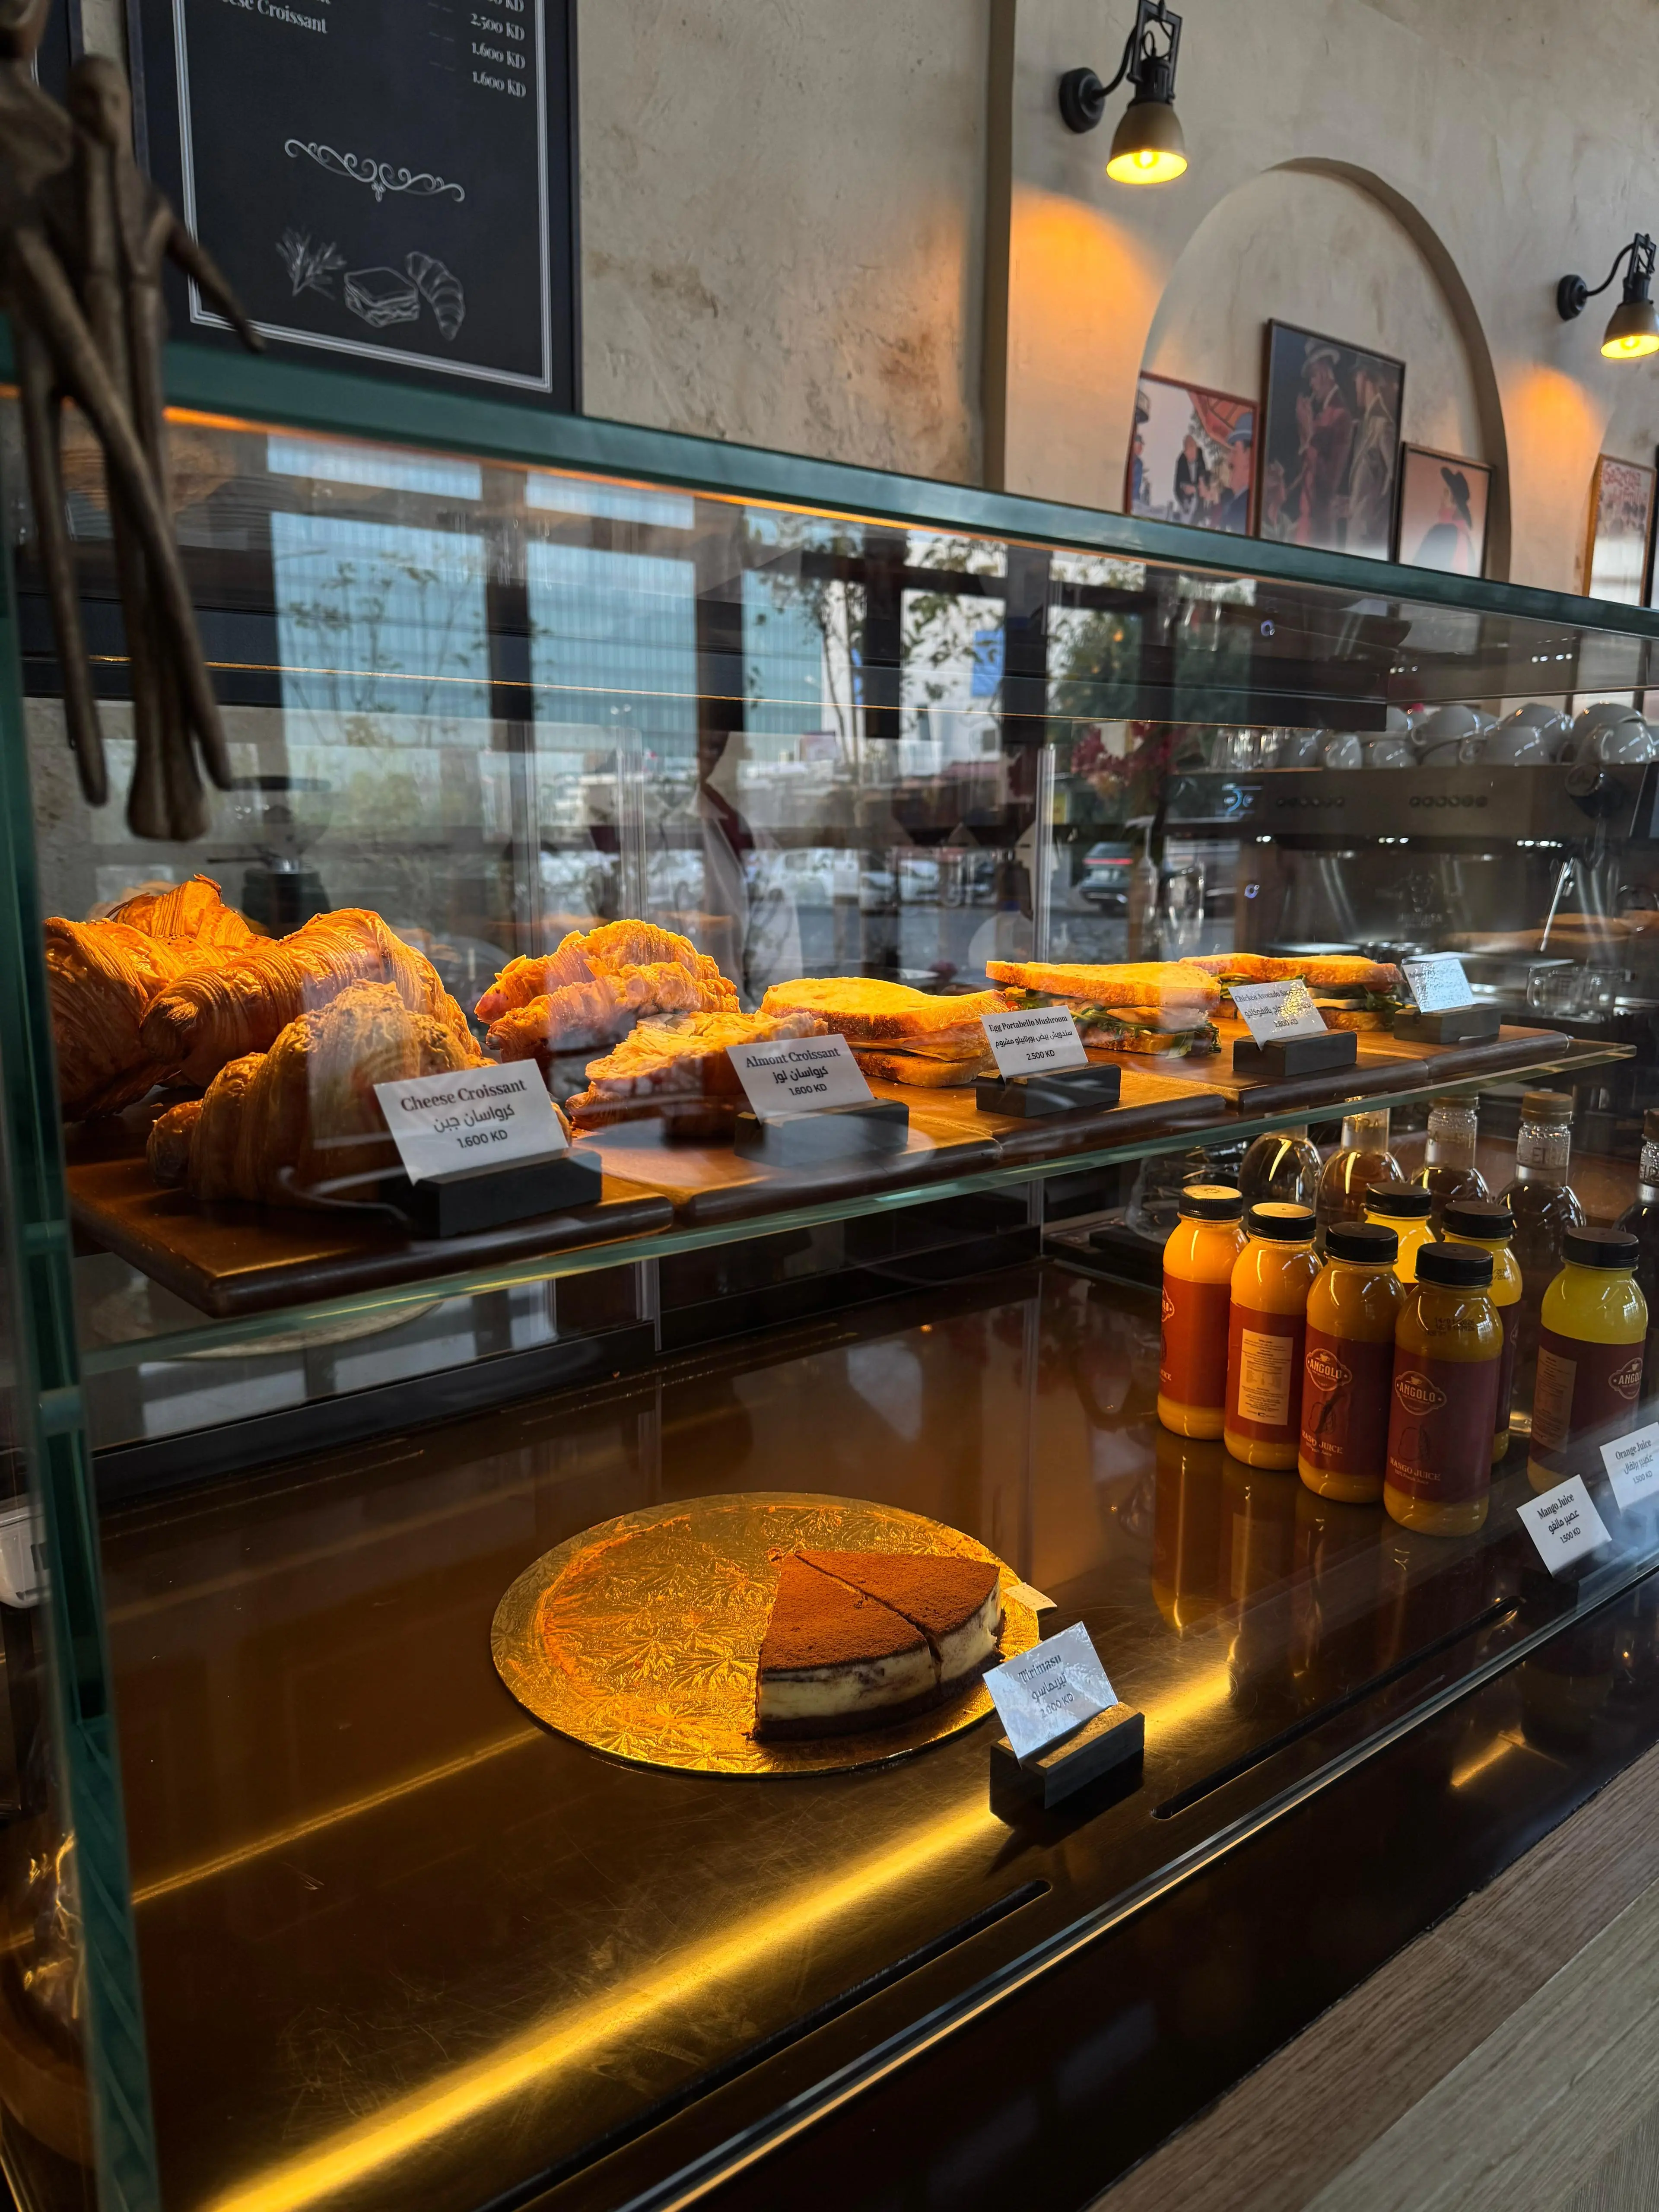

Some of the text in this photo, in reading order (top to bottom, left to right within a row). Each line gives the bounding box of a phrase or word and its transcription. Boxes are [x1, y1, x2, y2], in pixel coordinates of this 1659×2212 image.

[257, 0, 327, 34] Croissant
[470, 13, 525, 41] 2.500 KD
[472, 42, 526, 69] 1.600 KD
[472, 70, 526, 98] 1.600 KD
[1235, 994, 1258, 1003] Chicken
[988, 1016, 1068, 1033] Egg Portabello Mushroom
[995, 1038, 1014, 1049] مشروم
[1015, 1035, 1035, 1045] بورتابيلو
[1036, 1033, 1049, 1042] بيض
[746, 1048, 841, 1068] Almont Croissant
[1026, 1052, 1045, 1060] 2.500
[772, 1066, 829, 1084] كرواسان لوز
[400, 1079, 528, 1112] Cheese Croissant
[788, 1084, 827, 1096] 1.600 KD
[433, 1103, 515, 1133] كرواسان جبن
[456, 1129, 509, 1149] 1.600 KD
[1310, 1358, 1342, 1379] ANGOLO
[1399, 1382, 1435, 1402] ANGOLO
[1319, 1441, 1343, 1454] JUICE
[1615, 1440, 1651, 1460] Orange Juice
[1390, 1456, 1441, 1481] MANGO JUICE
[1624, 1454, 1653, 1475] عصير برتقال
[1633, 1470, 1653, 1484] 1.500 KD
[1537, 1494, 1574, 1520] Mango Juice
[1548, 1510, 1580, 1535] عصير مانغو
[1560, 1527, 1581, 1544] 1.500 KD
[1018, 1654, 1062, 1683] Tirimasu
[1031, 1672, 1067, 1704] تيريماسو
[1062, 1693, 1074, 1706] KD
